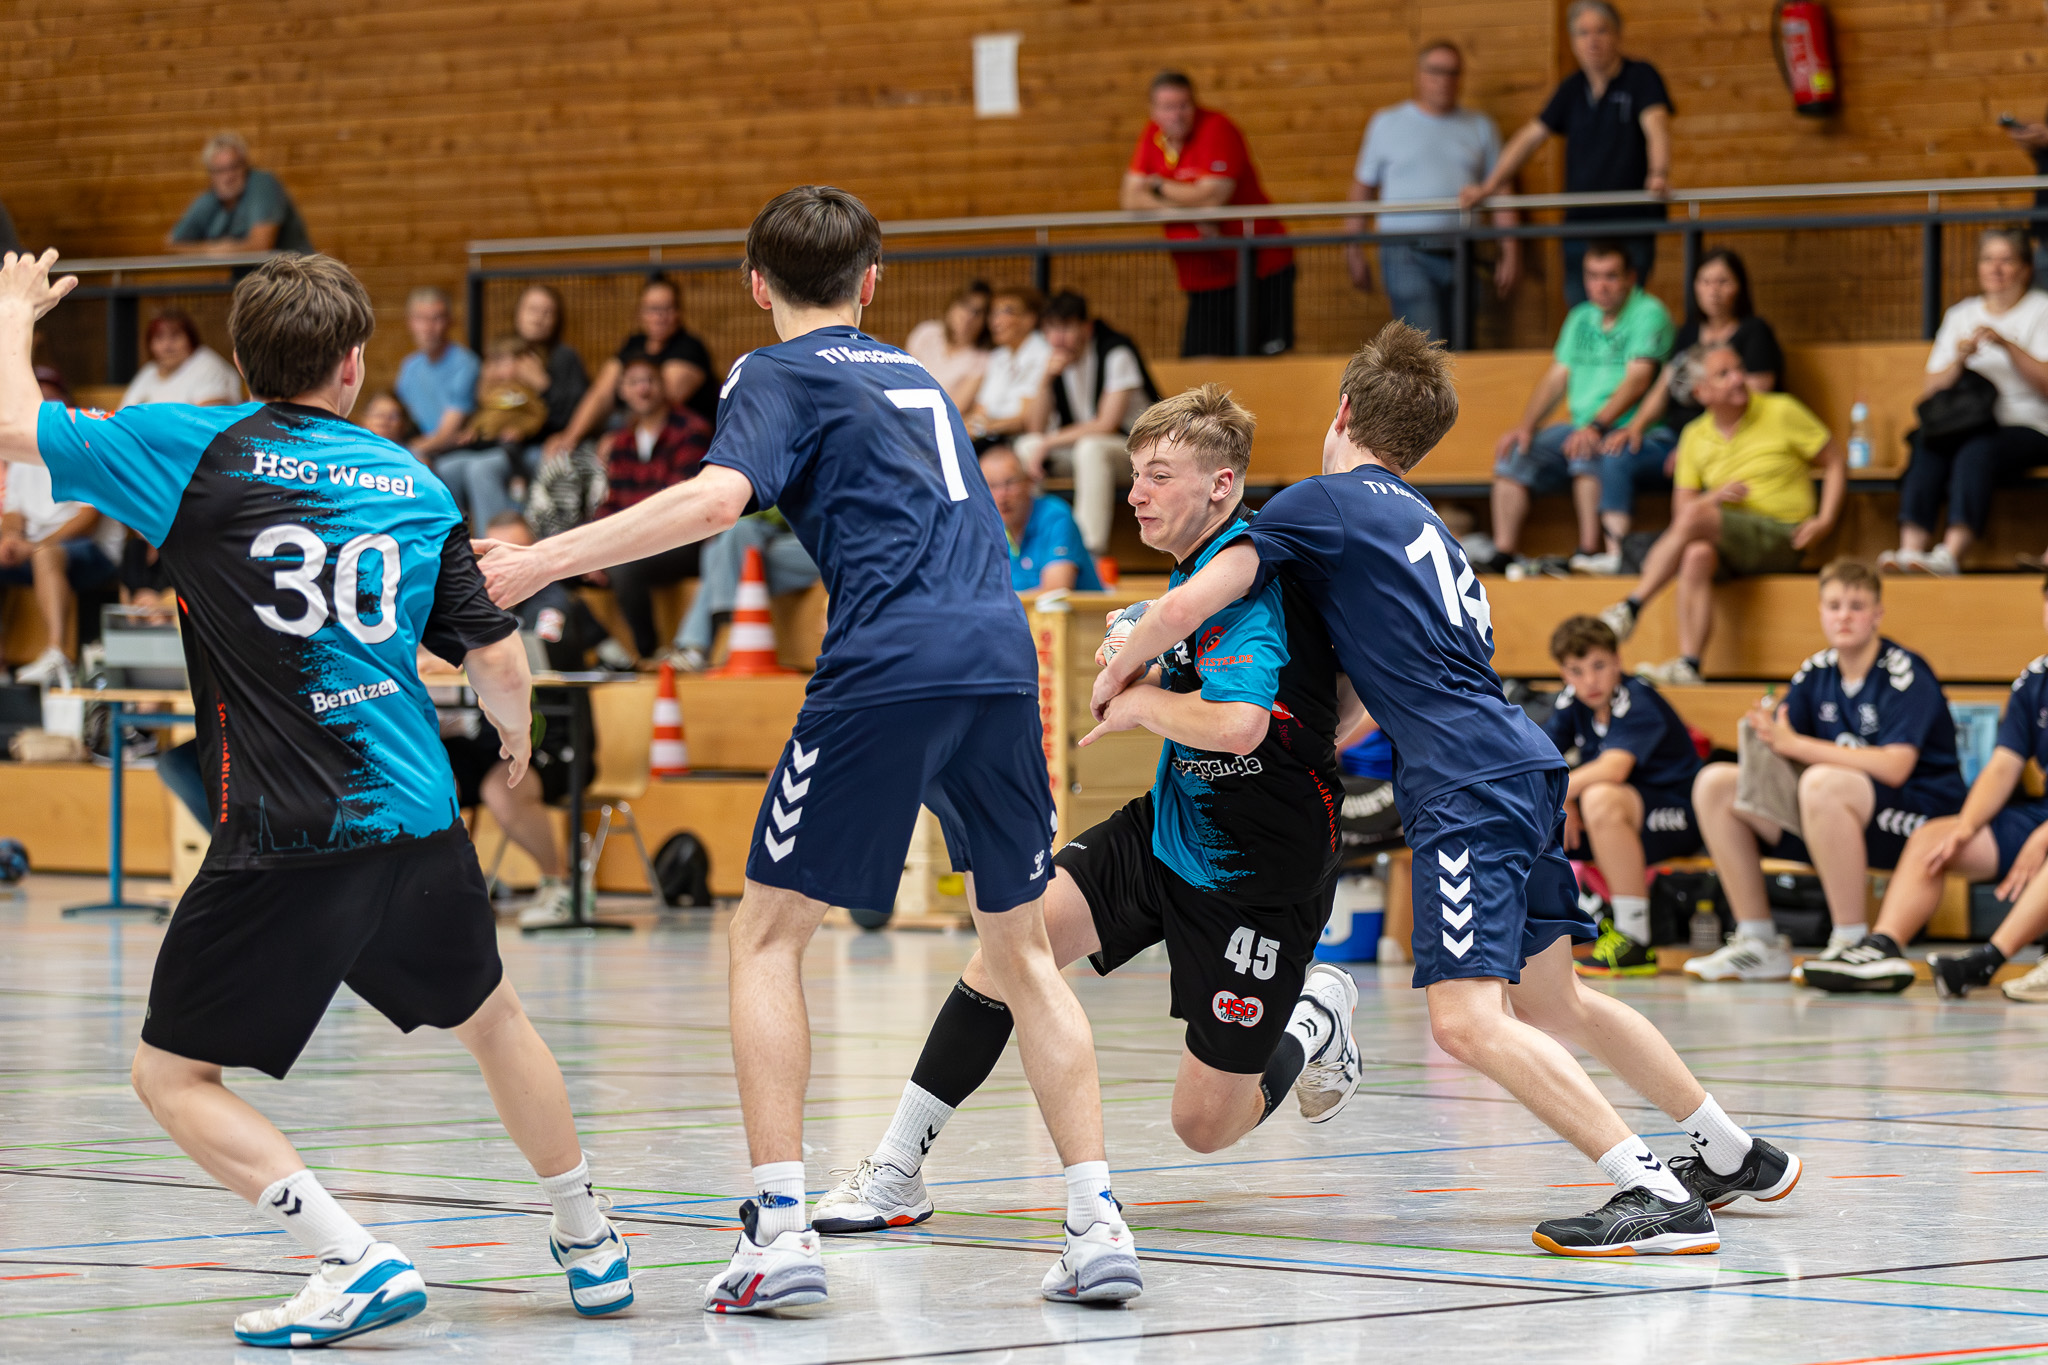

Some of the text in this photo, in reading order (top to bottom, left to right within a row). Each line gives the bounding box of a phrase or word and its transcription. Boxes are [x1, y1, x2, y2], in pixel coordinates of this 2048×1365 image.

[815, 347, 845, 364] TV
[884, 388, 969, 502] 7
[252, 451, 416, 499] HSG Wesel
[1362, 480, 1388, 495] TV
[249, 523, 402, 645] 30
[1404, 522, 1493, 647] 14
[1198, 654, 1254, 667] NISTER.DE
[309, 677, 400, 714] Berntzen
[1224, 925, 1281, 981] 45
[1218, 998, 1258, 1018] HSG
[1220, 1010, 1254, 1022] WESEL
